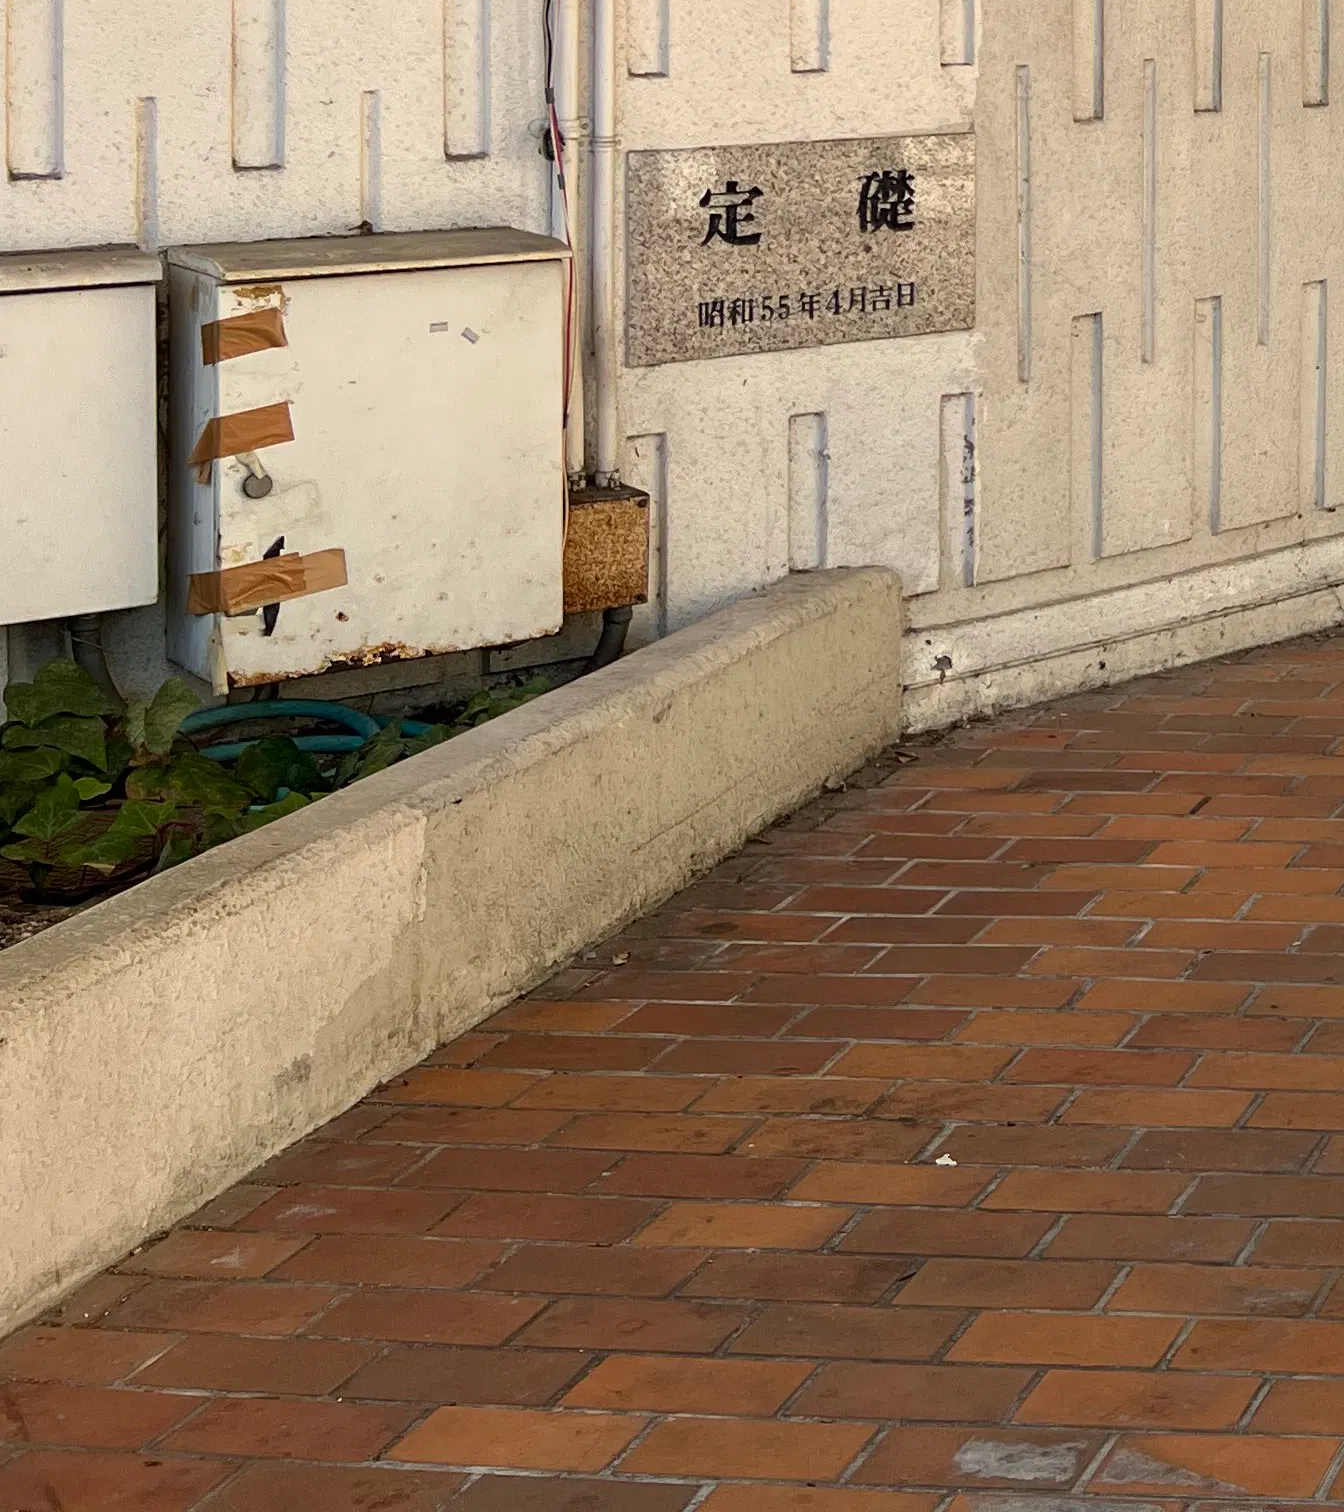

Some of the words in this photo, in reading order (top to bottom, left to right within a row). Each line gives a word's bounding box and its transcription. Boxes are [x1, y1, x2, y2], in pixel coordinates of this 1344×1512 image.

[698, 282, 916, 329] 昭和55年4月吉日
